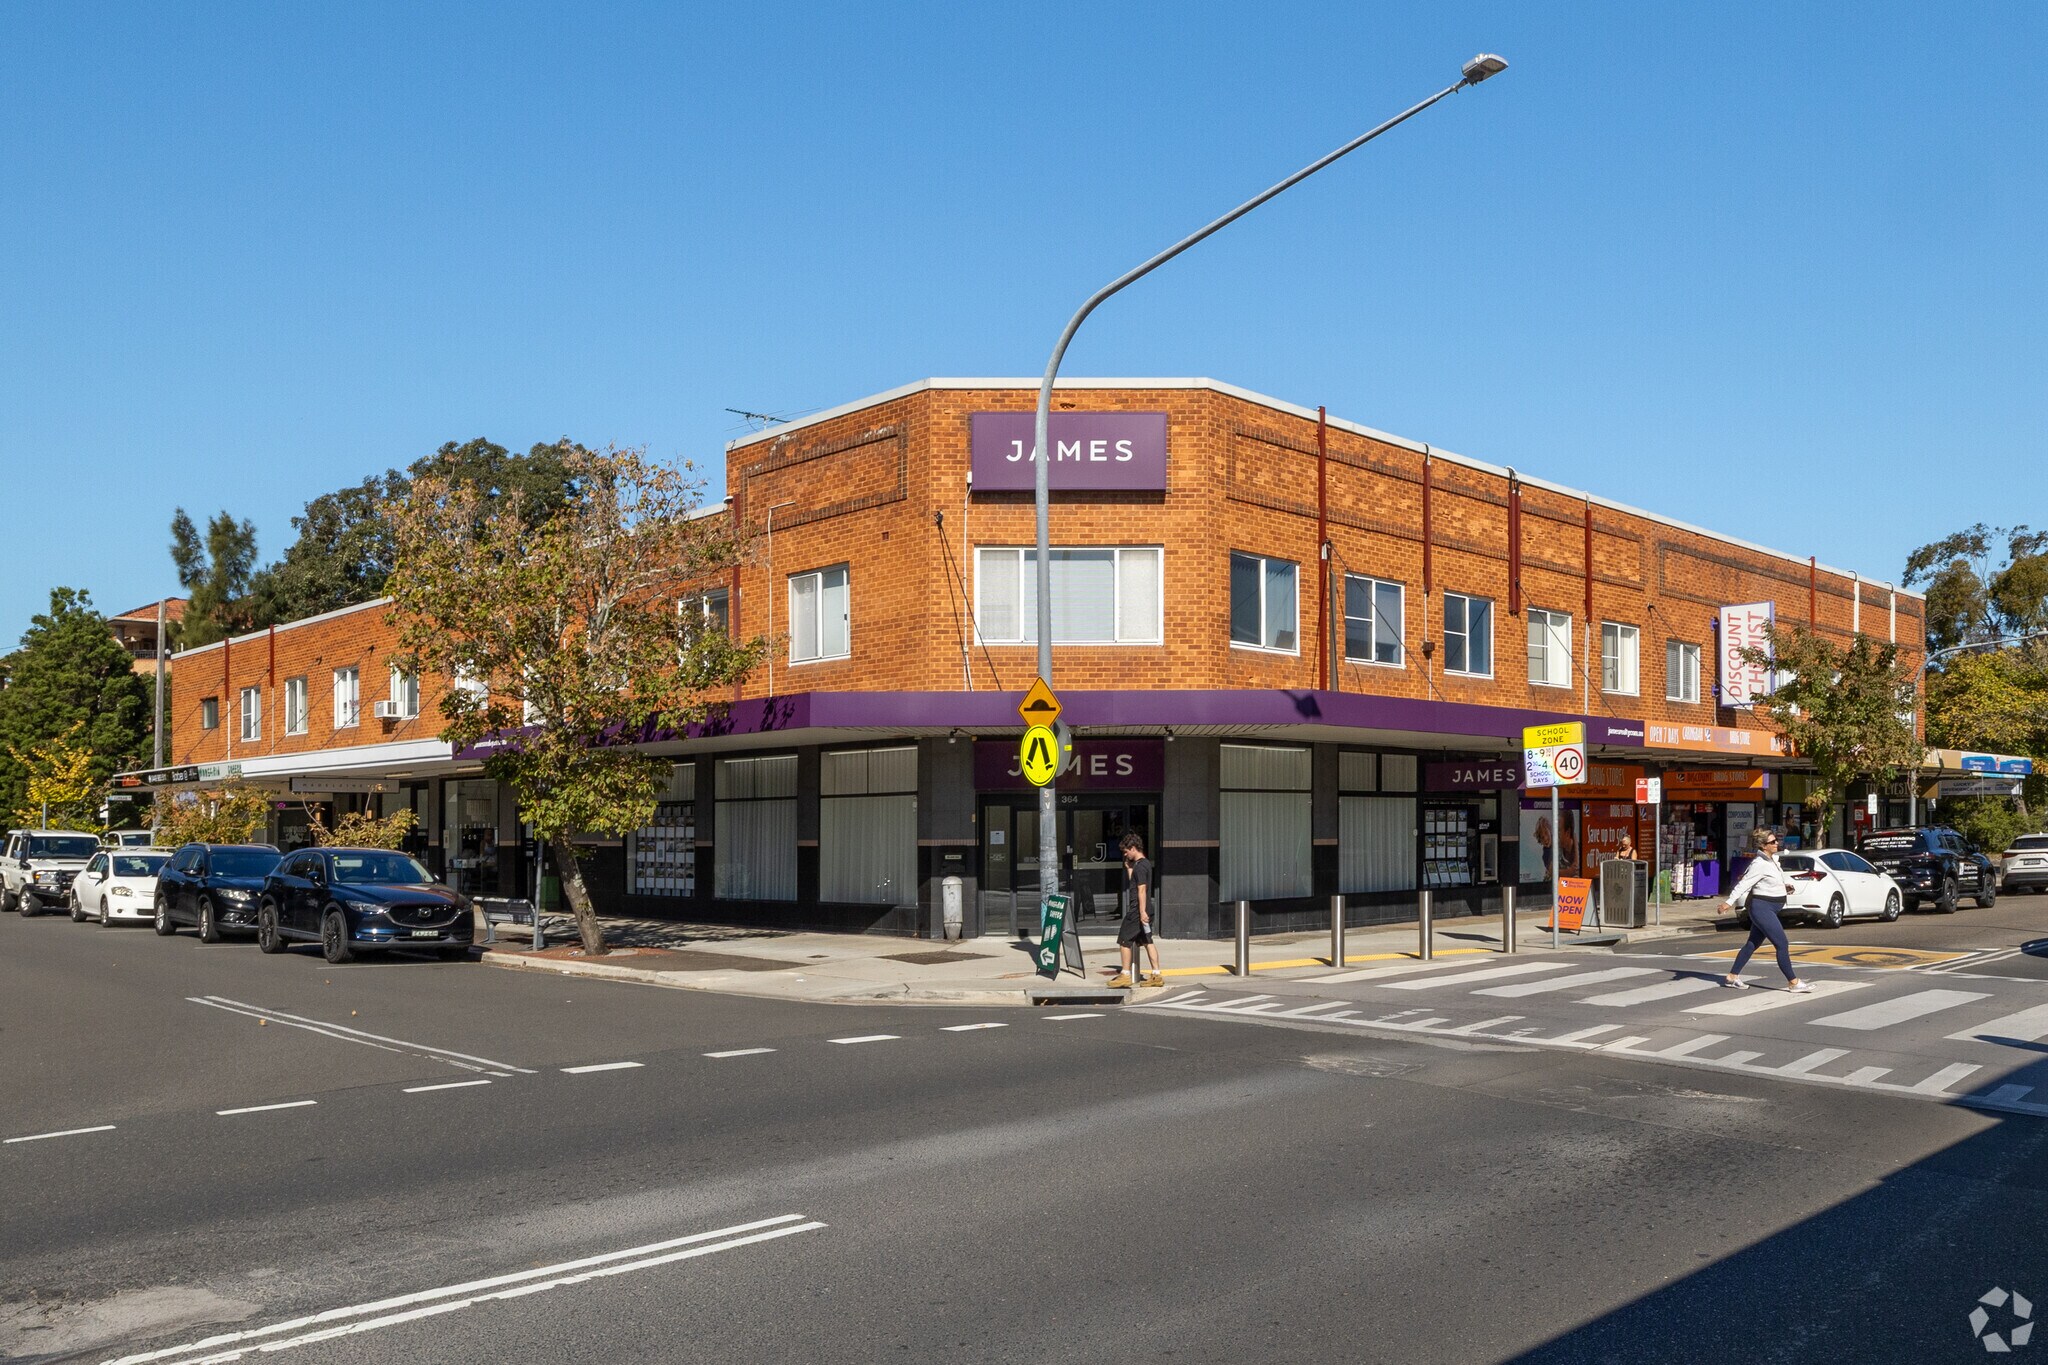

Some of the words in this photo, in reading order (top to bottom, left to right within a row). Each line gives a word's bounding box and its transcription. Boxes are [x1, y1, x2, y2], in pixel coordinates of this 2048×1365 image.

[1728, 613, 1742, 697] DISCOUNT
[1536, 727, 1569, 736] SCHOOL
[1650, 726, 1663, 743] OPEN
[1664, 727, 1668, 744] 7
[1668, 728, 1680, 745] DAYS
[1542, 736, 1564, 744] ZONE
[1007, 754, 1134, 777] JMES
[1560, 756, 1578, 770] 40
[1452, 769, 1516, 783] JAMES
[1590, 767, 1606, 786] DRUG
[1606, 768, 1625, 787] STORES
[1714, 772, 1728, 782] DRUG
[1730, 771, 1749, 782] STORES
[1588, 824, 1600, 843] Save
[1601, 829, 1608, 846] up
[1609, 826, 1616, 842] to
[1586, 848, 1597, 868] off
[1558, 895, 1584, 905] NOW
